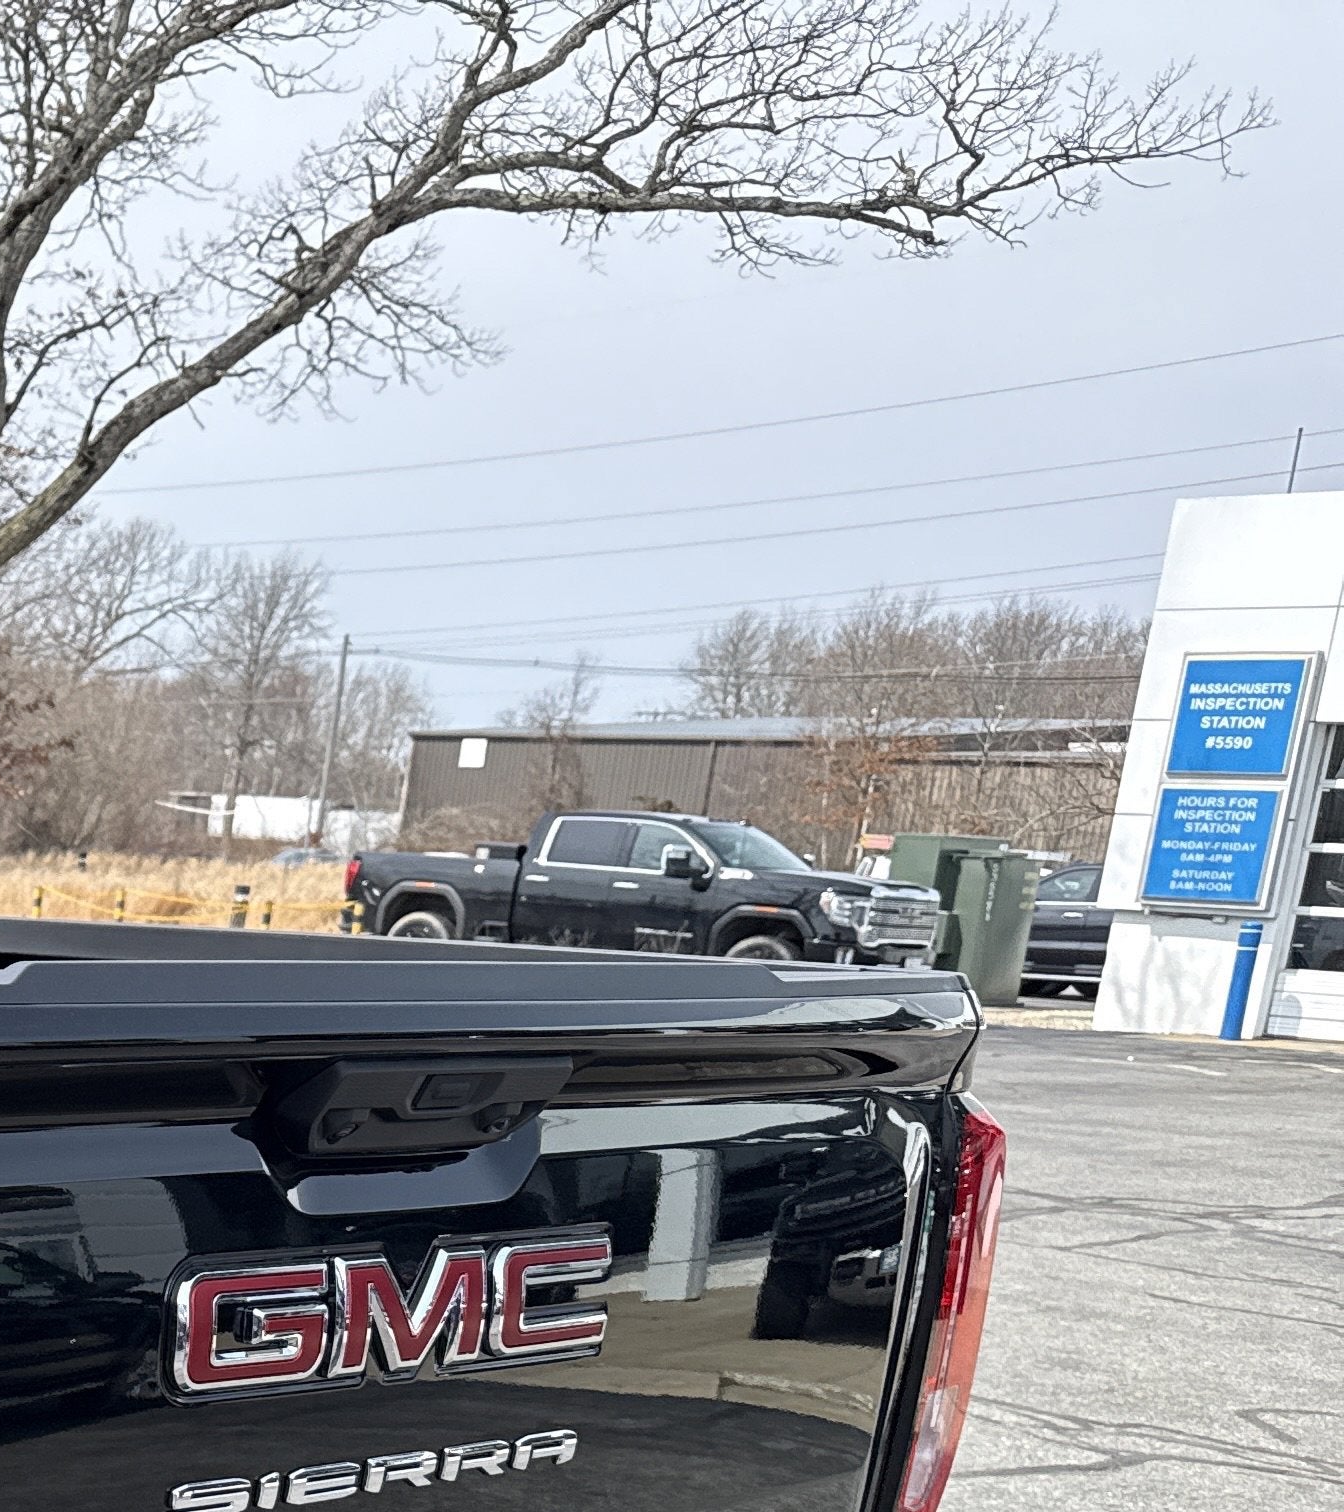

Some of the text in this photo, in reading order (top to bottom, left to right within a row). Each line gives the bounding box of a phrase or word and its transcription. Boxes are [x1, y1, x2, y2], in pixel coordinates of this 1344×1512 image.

[1189, 682, 1292, 695] MASSACHUSETTS
[1190, 697, 1285, 711] INSPECTION
[1200, 715, 1267, 730] STATION
[1205, 735, 1253, 750] #5590
[1177, 796, 1259, 809] HOURS FOR
[1174, 809, 1257, 822] INSPECTION
[1183, 822, 1241, 834] STATION
[1161, 839, 1257, 852] MONDAY-FRIDAY
[1171, 868, 1235, 880] SATURDAY
[173, 1231, 612, 1393] GMC
